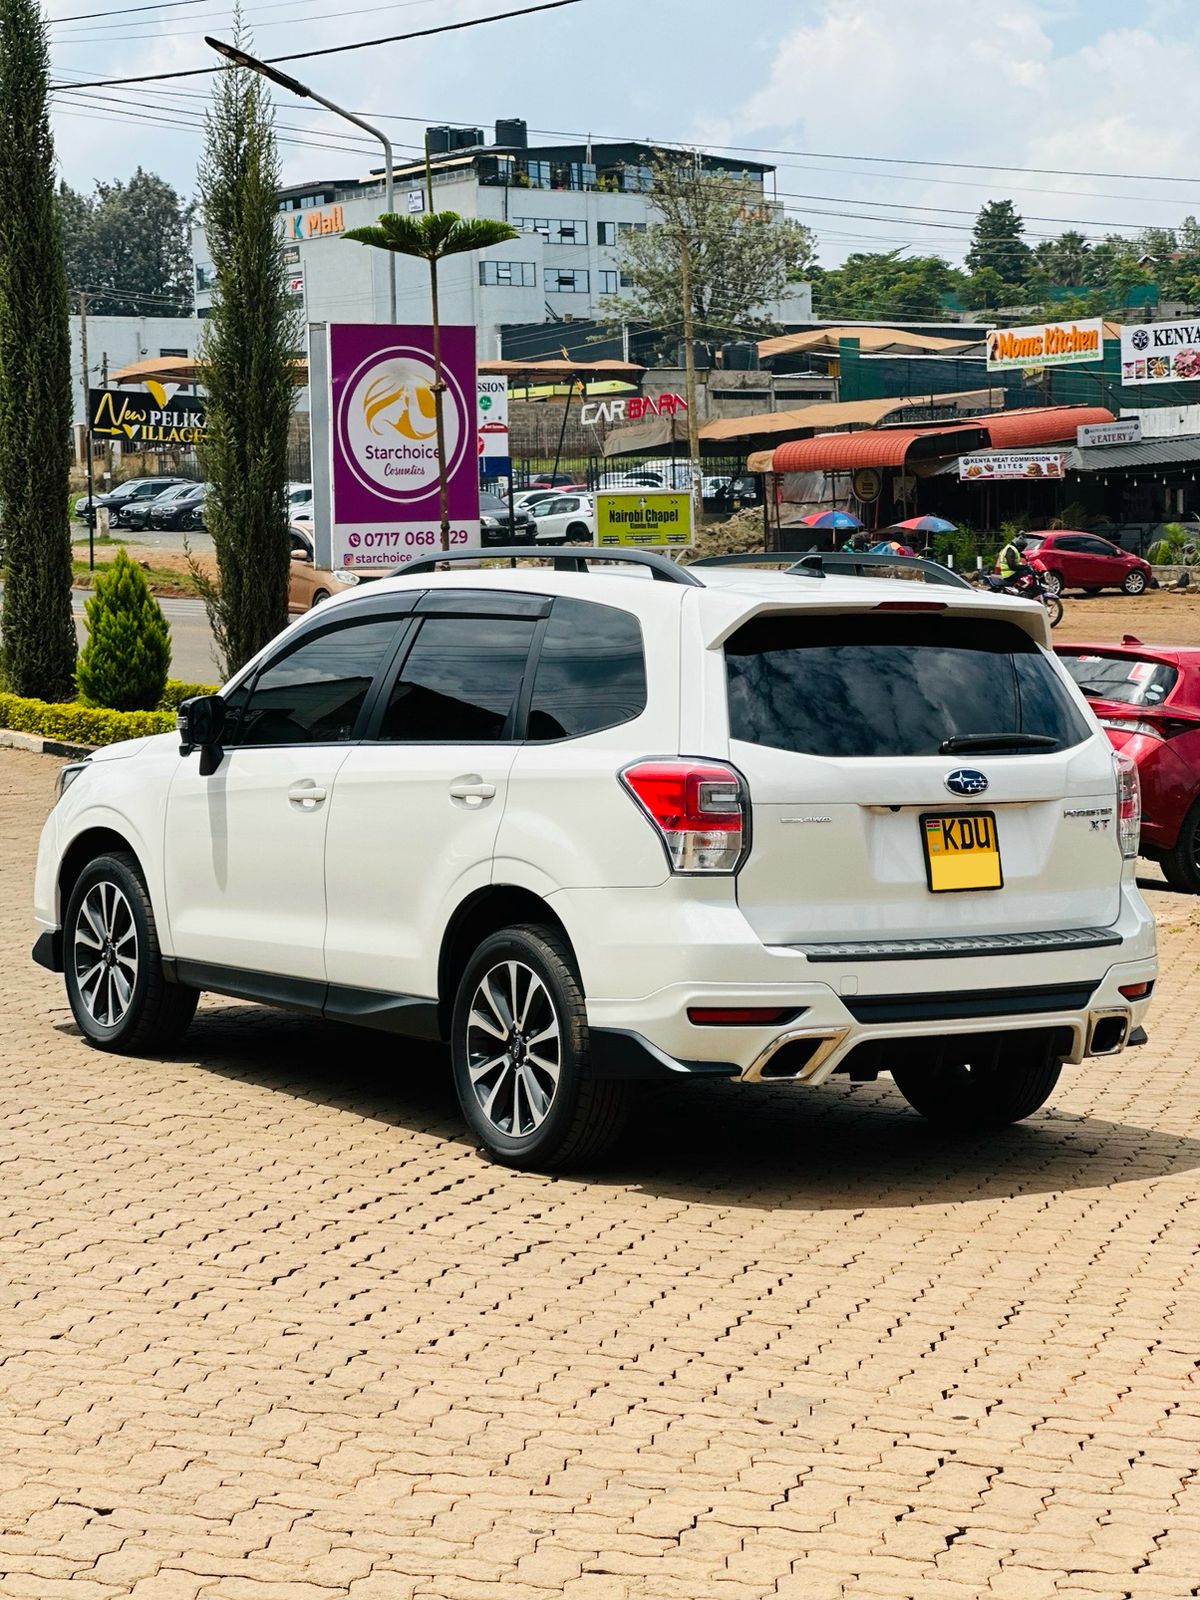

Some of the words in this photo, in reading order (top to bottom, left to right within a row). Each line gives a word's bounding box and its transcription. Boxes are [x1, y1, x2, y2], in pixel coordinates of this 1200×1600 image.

[306, 206, 345, 237] Mall
[998, 331, 1043, 360] Moms
[1044, 325, 1099, 355] Kitchen
[1152, 325, 1200, 347] KENYA
[94, 393, 147, 426] New
[1097, 433, 1127, 443] EATERY
[365, 444, 440, 460] Starchoice
[970, 457, 991, 465] KENYA
[992, 456, 1009, 464] MEAT
[1010, 455, 1051, 463] COMMISSION
[384, 463, 426, 477] Cosmetics
[609, 508, 644, 523] Nairobi
[645, 508, 679, 523] Chapel
[364, 532, 400, 547] 0717
[405, 531, 435, 546] 068
[440, 530, 468, 545] 29
[1089, 818, 1111, 832] XT
[942, 817, 991, 851] KDU
